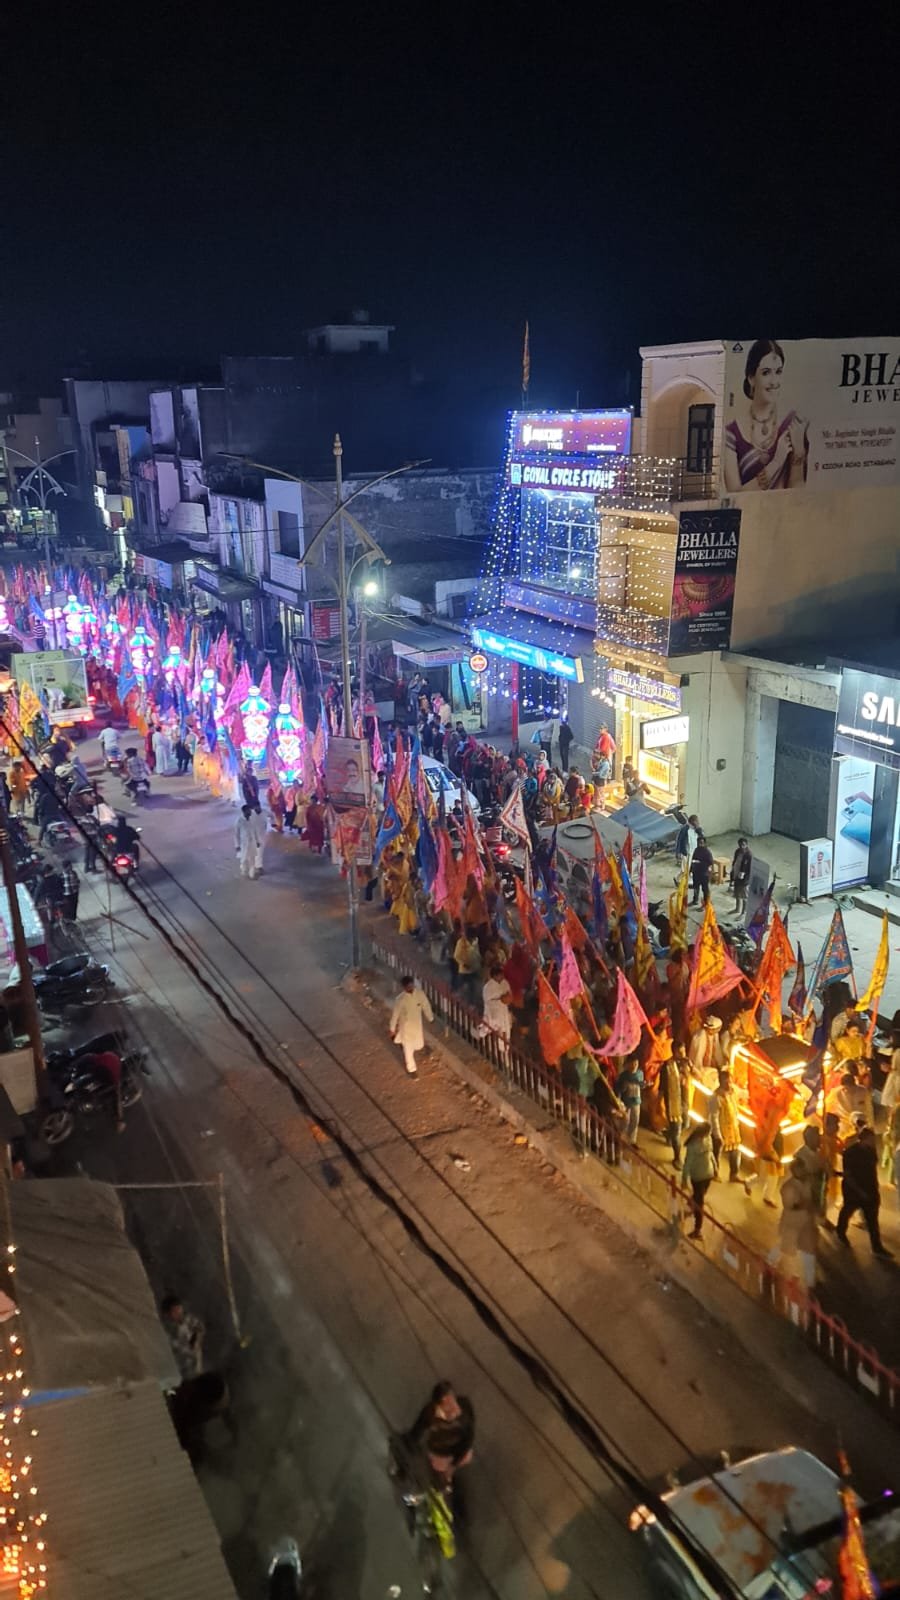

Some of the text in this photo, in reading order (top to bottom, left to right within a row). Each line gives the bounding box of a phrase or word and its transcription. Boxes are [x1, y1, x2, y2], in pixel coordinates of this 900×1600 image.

[523, 465, 616, 489] GOYAL CYCLE STORE
[679, 531, 738, 548] BHALLA
[677, 548, 737, 561] JEWELLERS
[861, 691, 900, 727] SA
